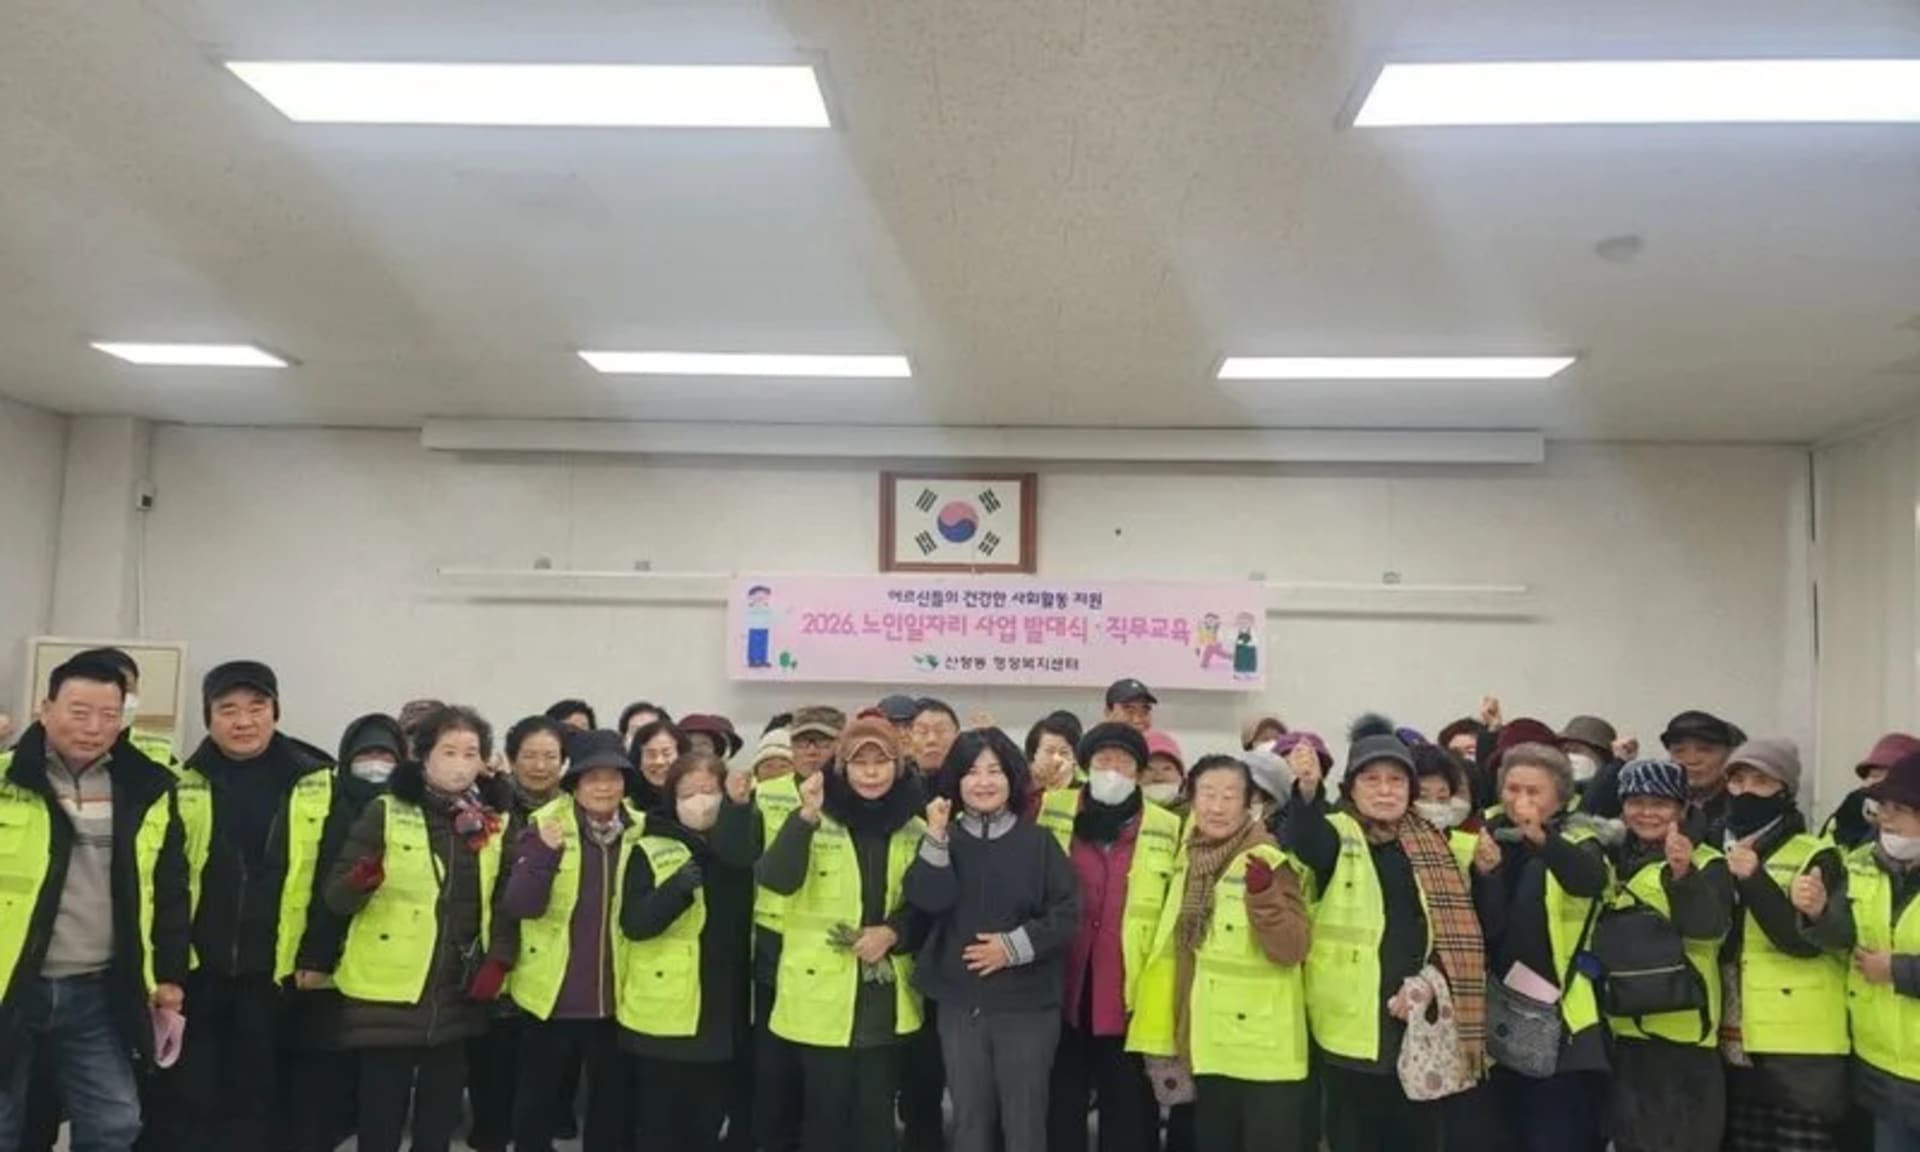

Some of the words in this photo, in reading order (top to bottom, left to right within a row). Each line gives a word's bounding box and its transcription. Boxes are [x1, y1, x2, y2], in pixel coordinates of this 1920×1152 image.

[888, 590, 958, 608] 어르신들의
[963, 590, 1006, 609] 건강한
[1011, 590, 1067, 610] 사회활동
[1072, 591, 1102, 610] 지원
[802, 612, 858, 636] 2026.
[862, 612, 967, 642] 노인일자리
[975, 615, 1017, 644] 사업
[1024, 615, 1088, 645] 발대식
[1106, 616, 1191, 646] 직무교육
[993, 656, 1079, 672] 행정복지센터
